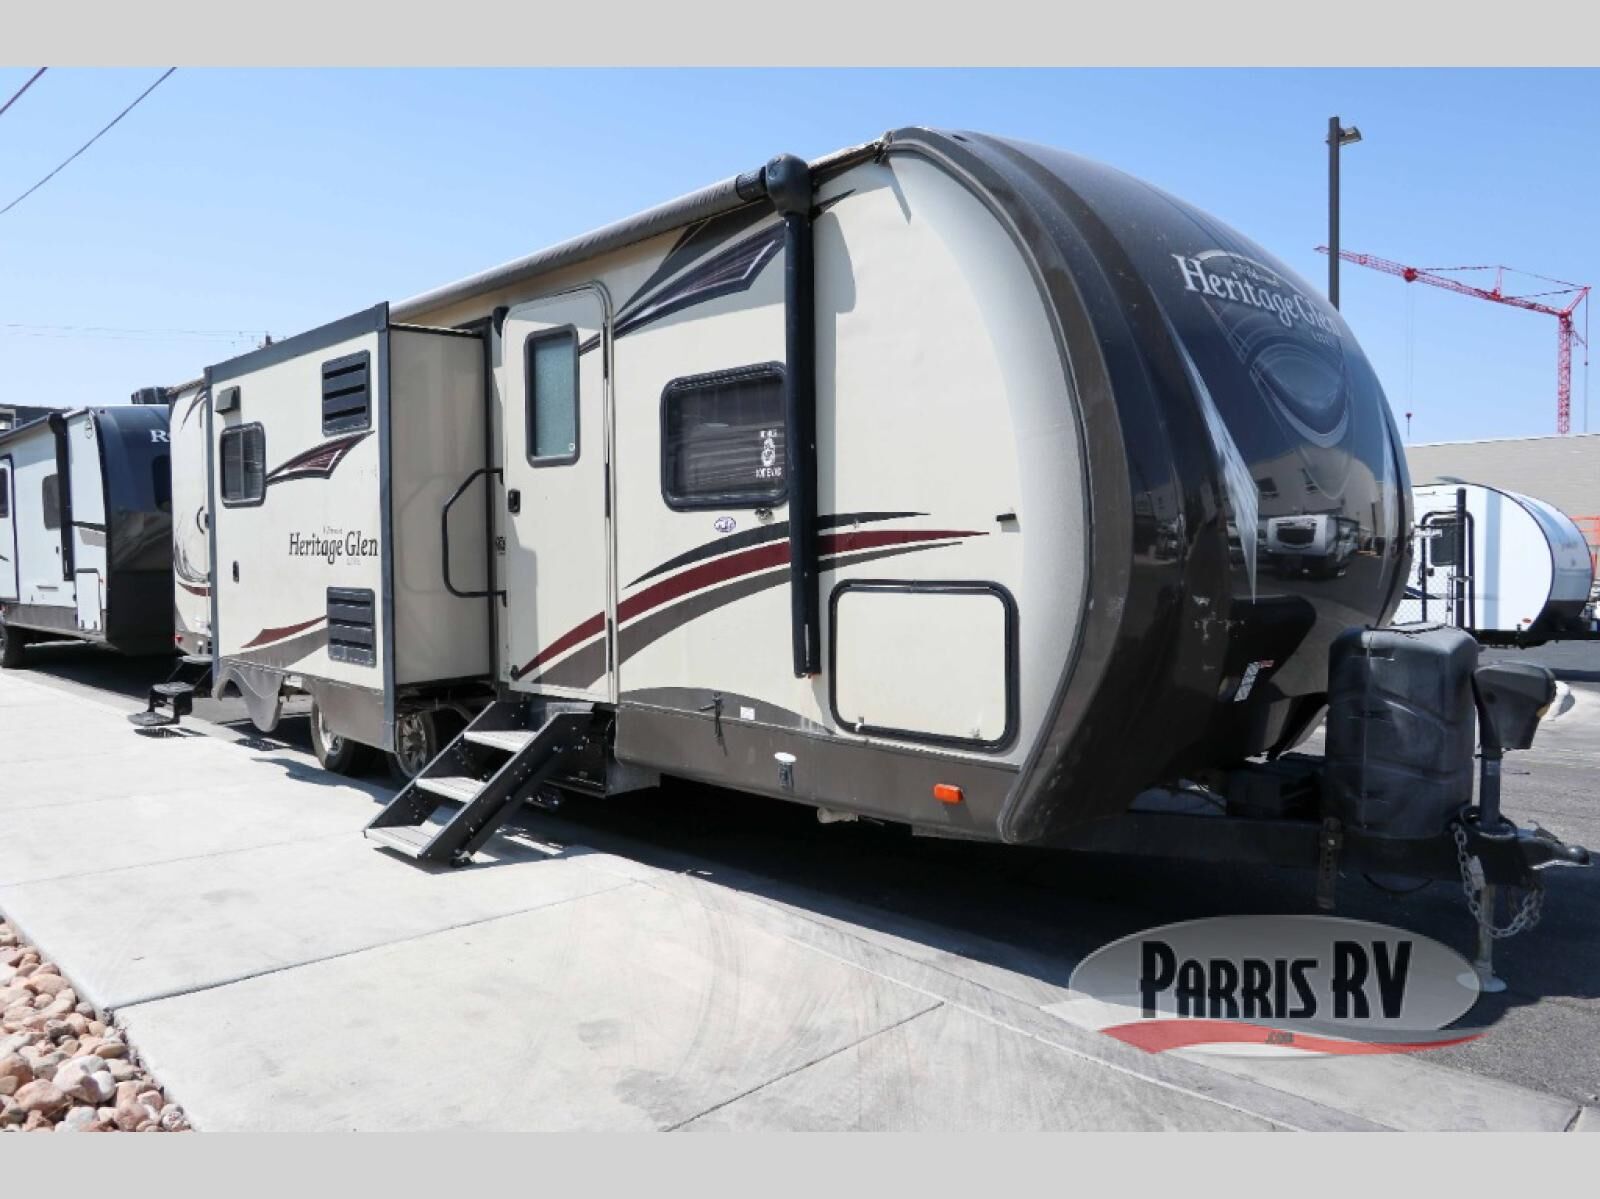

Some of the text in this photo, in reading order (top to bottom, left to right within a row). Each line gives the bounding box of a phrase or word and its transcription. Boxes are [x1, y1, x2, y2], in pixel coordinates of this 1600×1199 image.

[1170, 253, 1300, 327] Heritage
[1295, 294, 1343, 338] Glen
[289, 530, 378, 565] Heritage Glen
